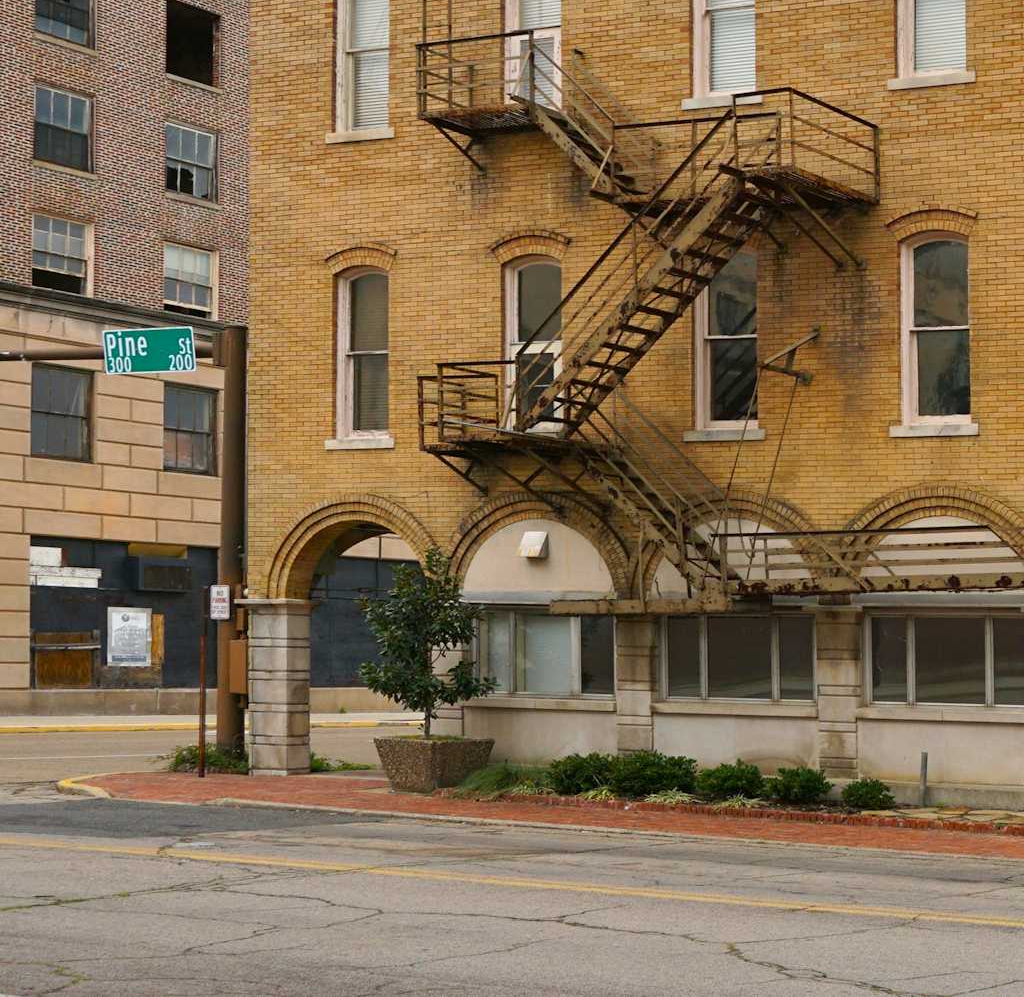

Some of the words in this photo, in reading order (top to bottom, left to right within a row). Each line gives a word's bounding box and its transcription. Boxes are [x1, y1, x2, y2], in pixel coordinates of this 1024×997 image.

[106, 331, 148, 357] Pine
[108, 357, 132, 373] 300
[168, 354, 192, 370] 200
